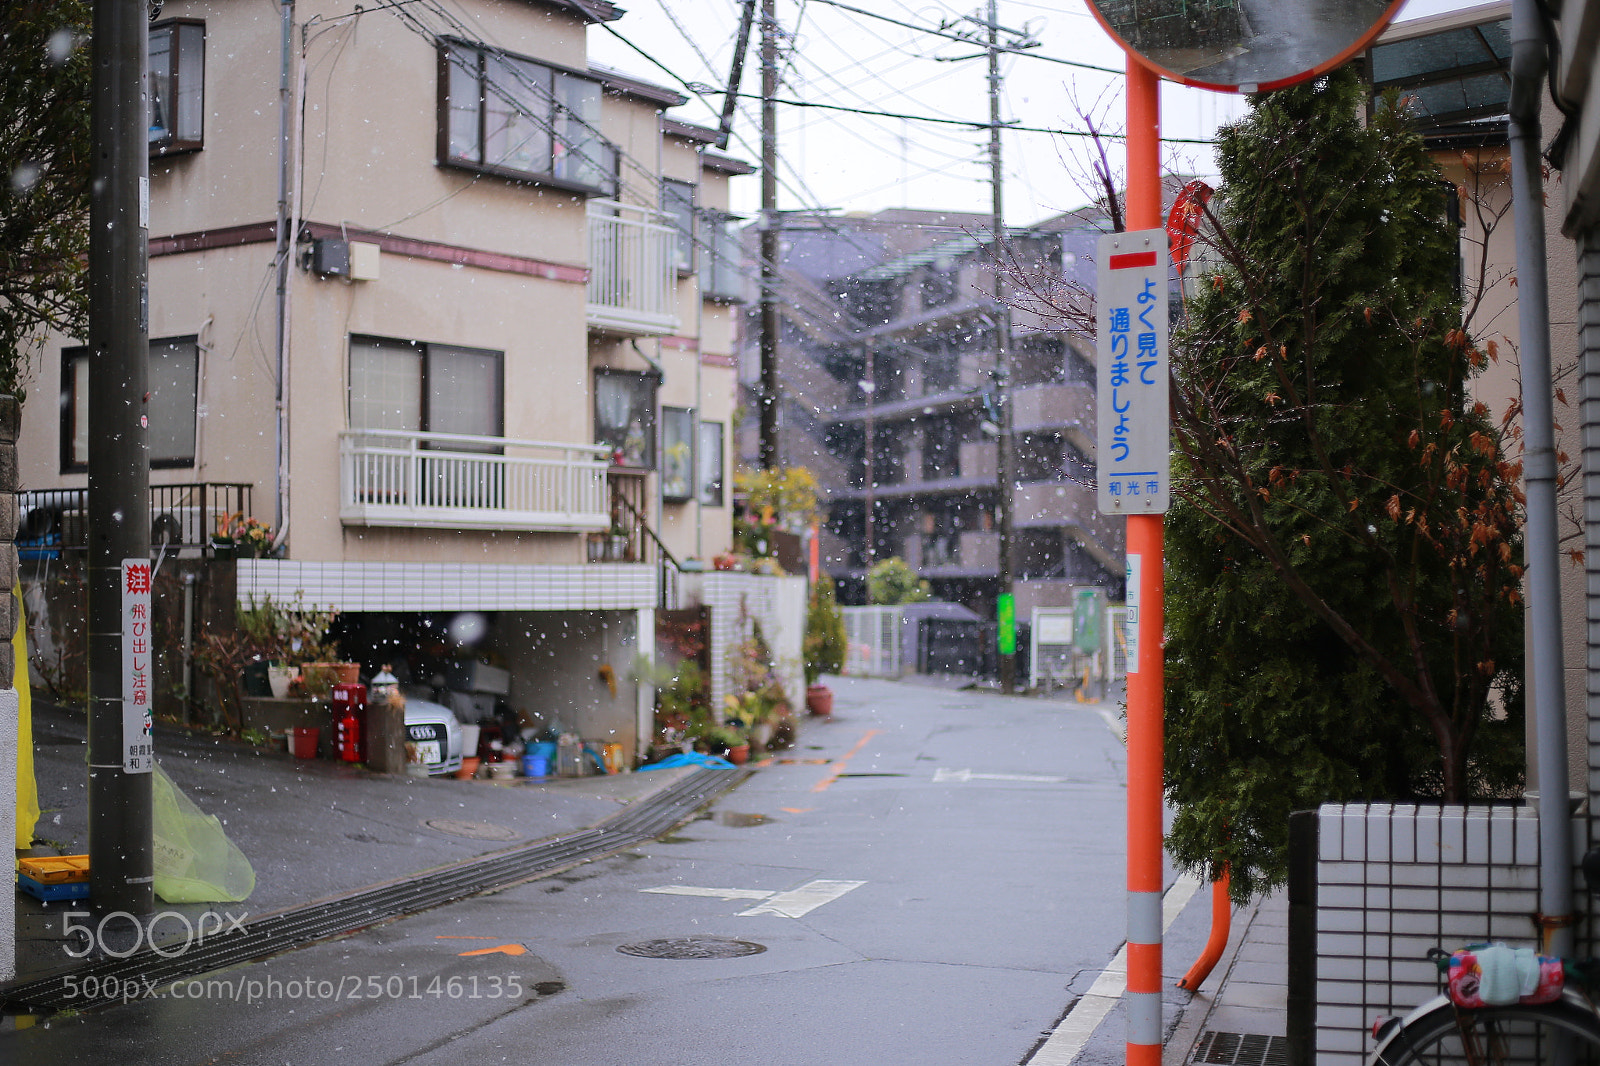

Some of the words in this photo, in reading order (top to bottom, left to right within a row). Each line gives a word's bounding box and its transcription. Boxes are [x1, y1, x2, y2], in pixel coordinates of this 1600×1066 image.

[1136, 278, 1158, 385] よく見て
[1109, 307, 1131, 462] 通りましょう
[1108, 480, 1159, 496] 和光市
[132, 603, 147, 706] 飛び出し注意
